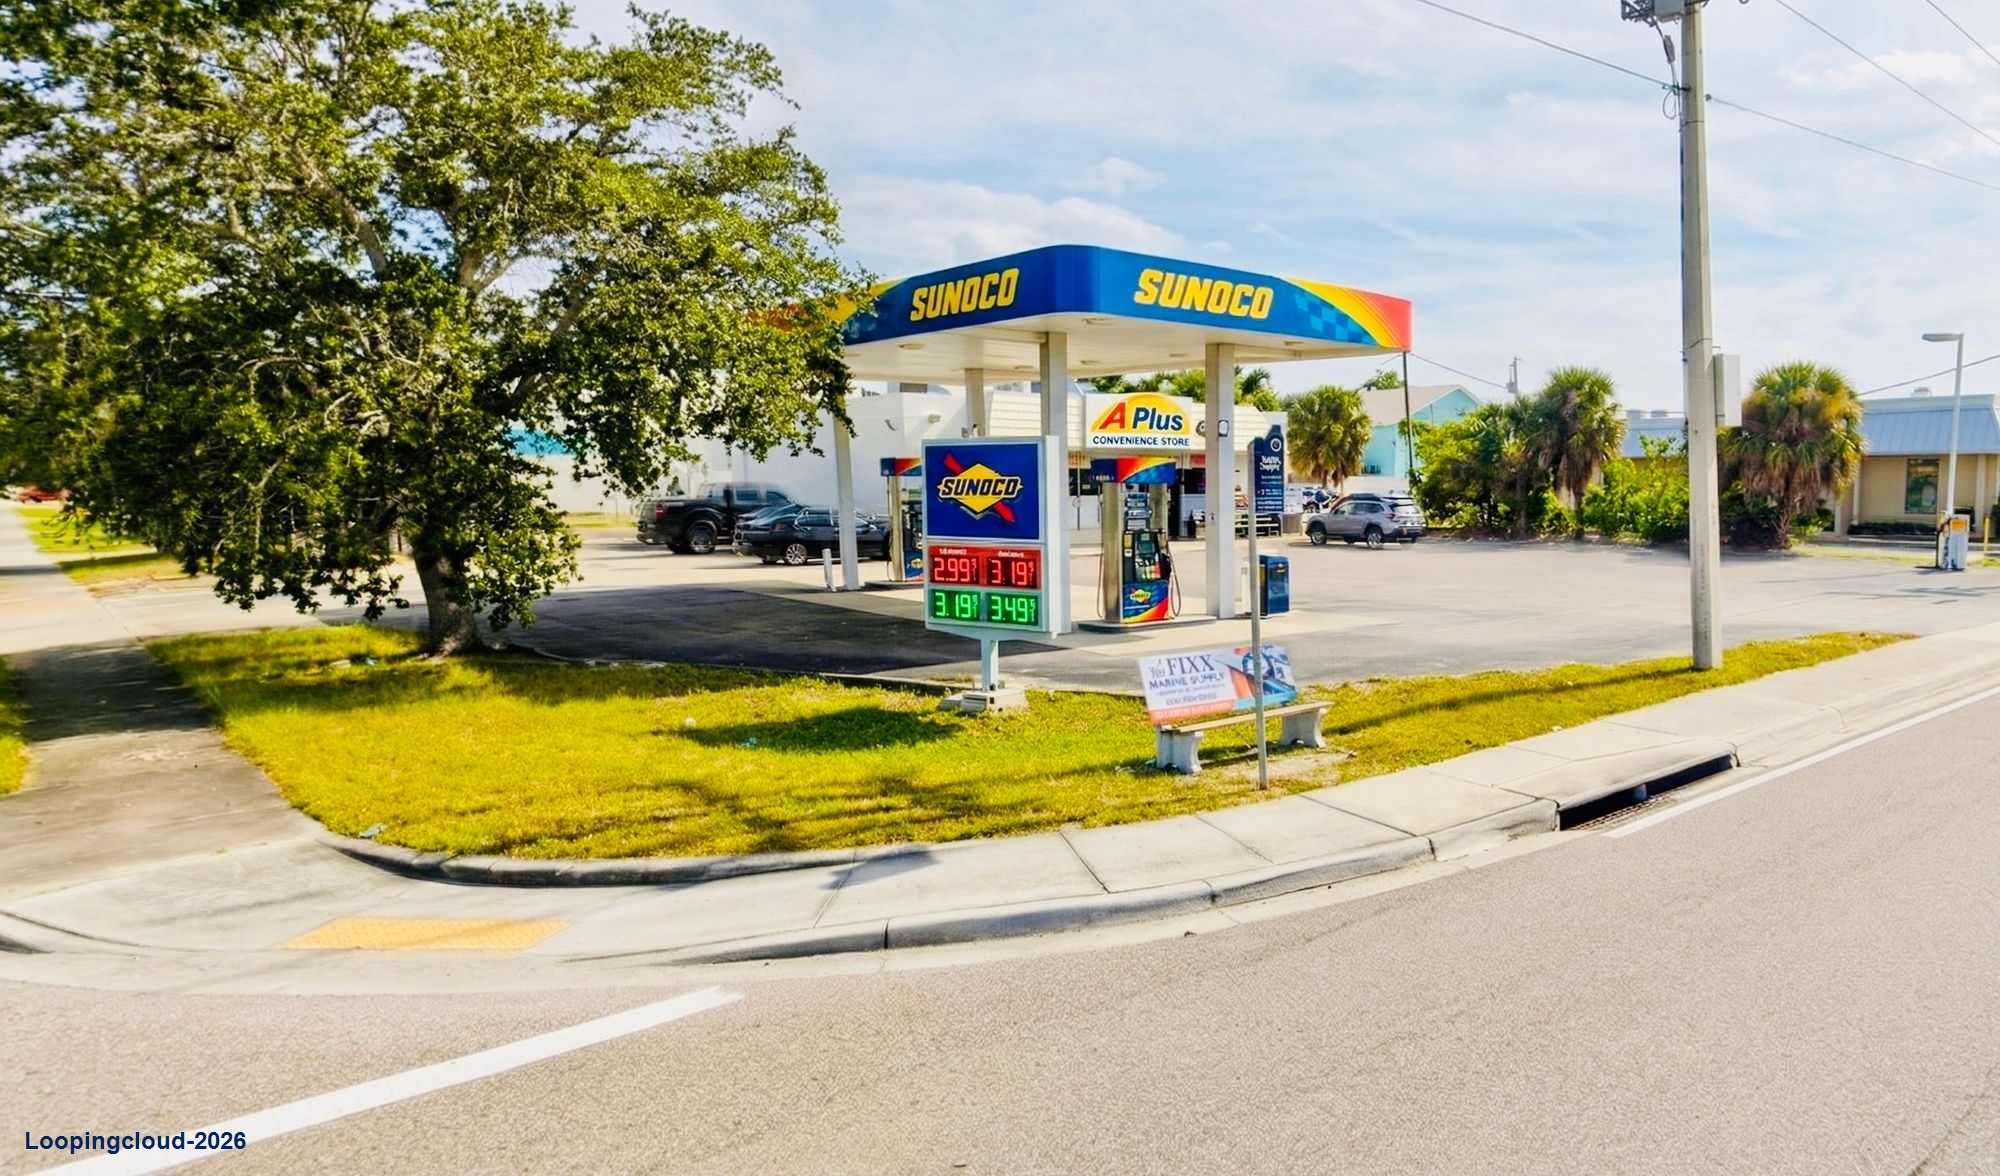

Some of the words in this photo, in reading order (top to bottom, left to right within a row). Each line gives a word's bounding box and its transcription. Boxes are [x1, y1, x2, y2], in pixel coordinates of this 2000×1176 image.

[910, 268, 1019, 322] SUNOCO
[1134, 269, 1274, 320] SUNOCO
[1099, 402, 1126, 430] A
[1132, 407, 1184, 432] Plus
[1093, 436, 1158, 446] CONVENIENCE
[1160, 437, 1190, 447] STORE
[941, 478, 1019, 497] SUNOCO
[1166, 655, 1215, 675] FIXX
